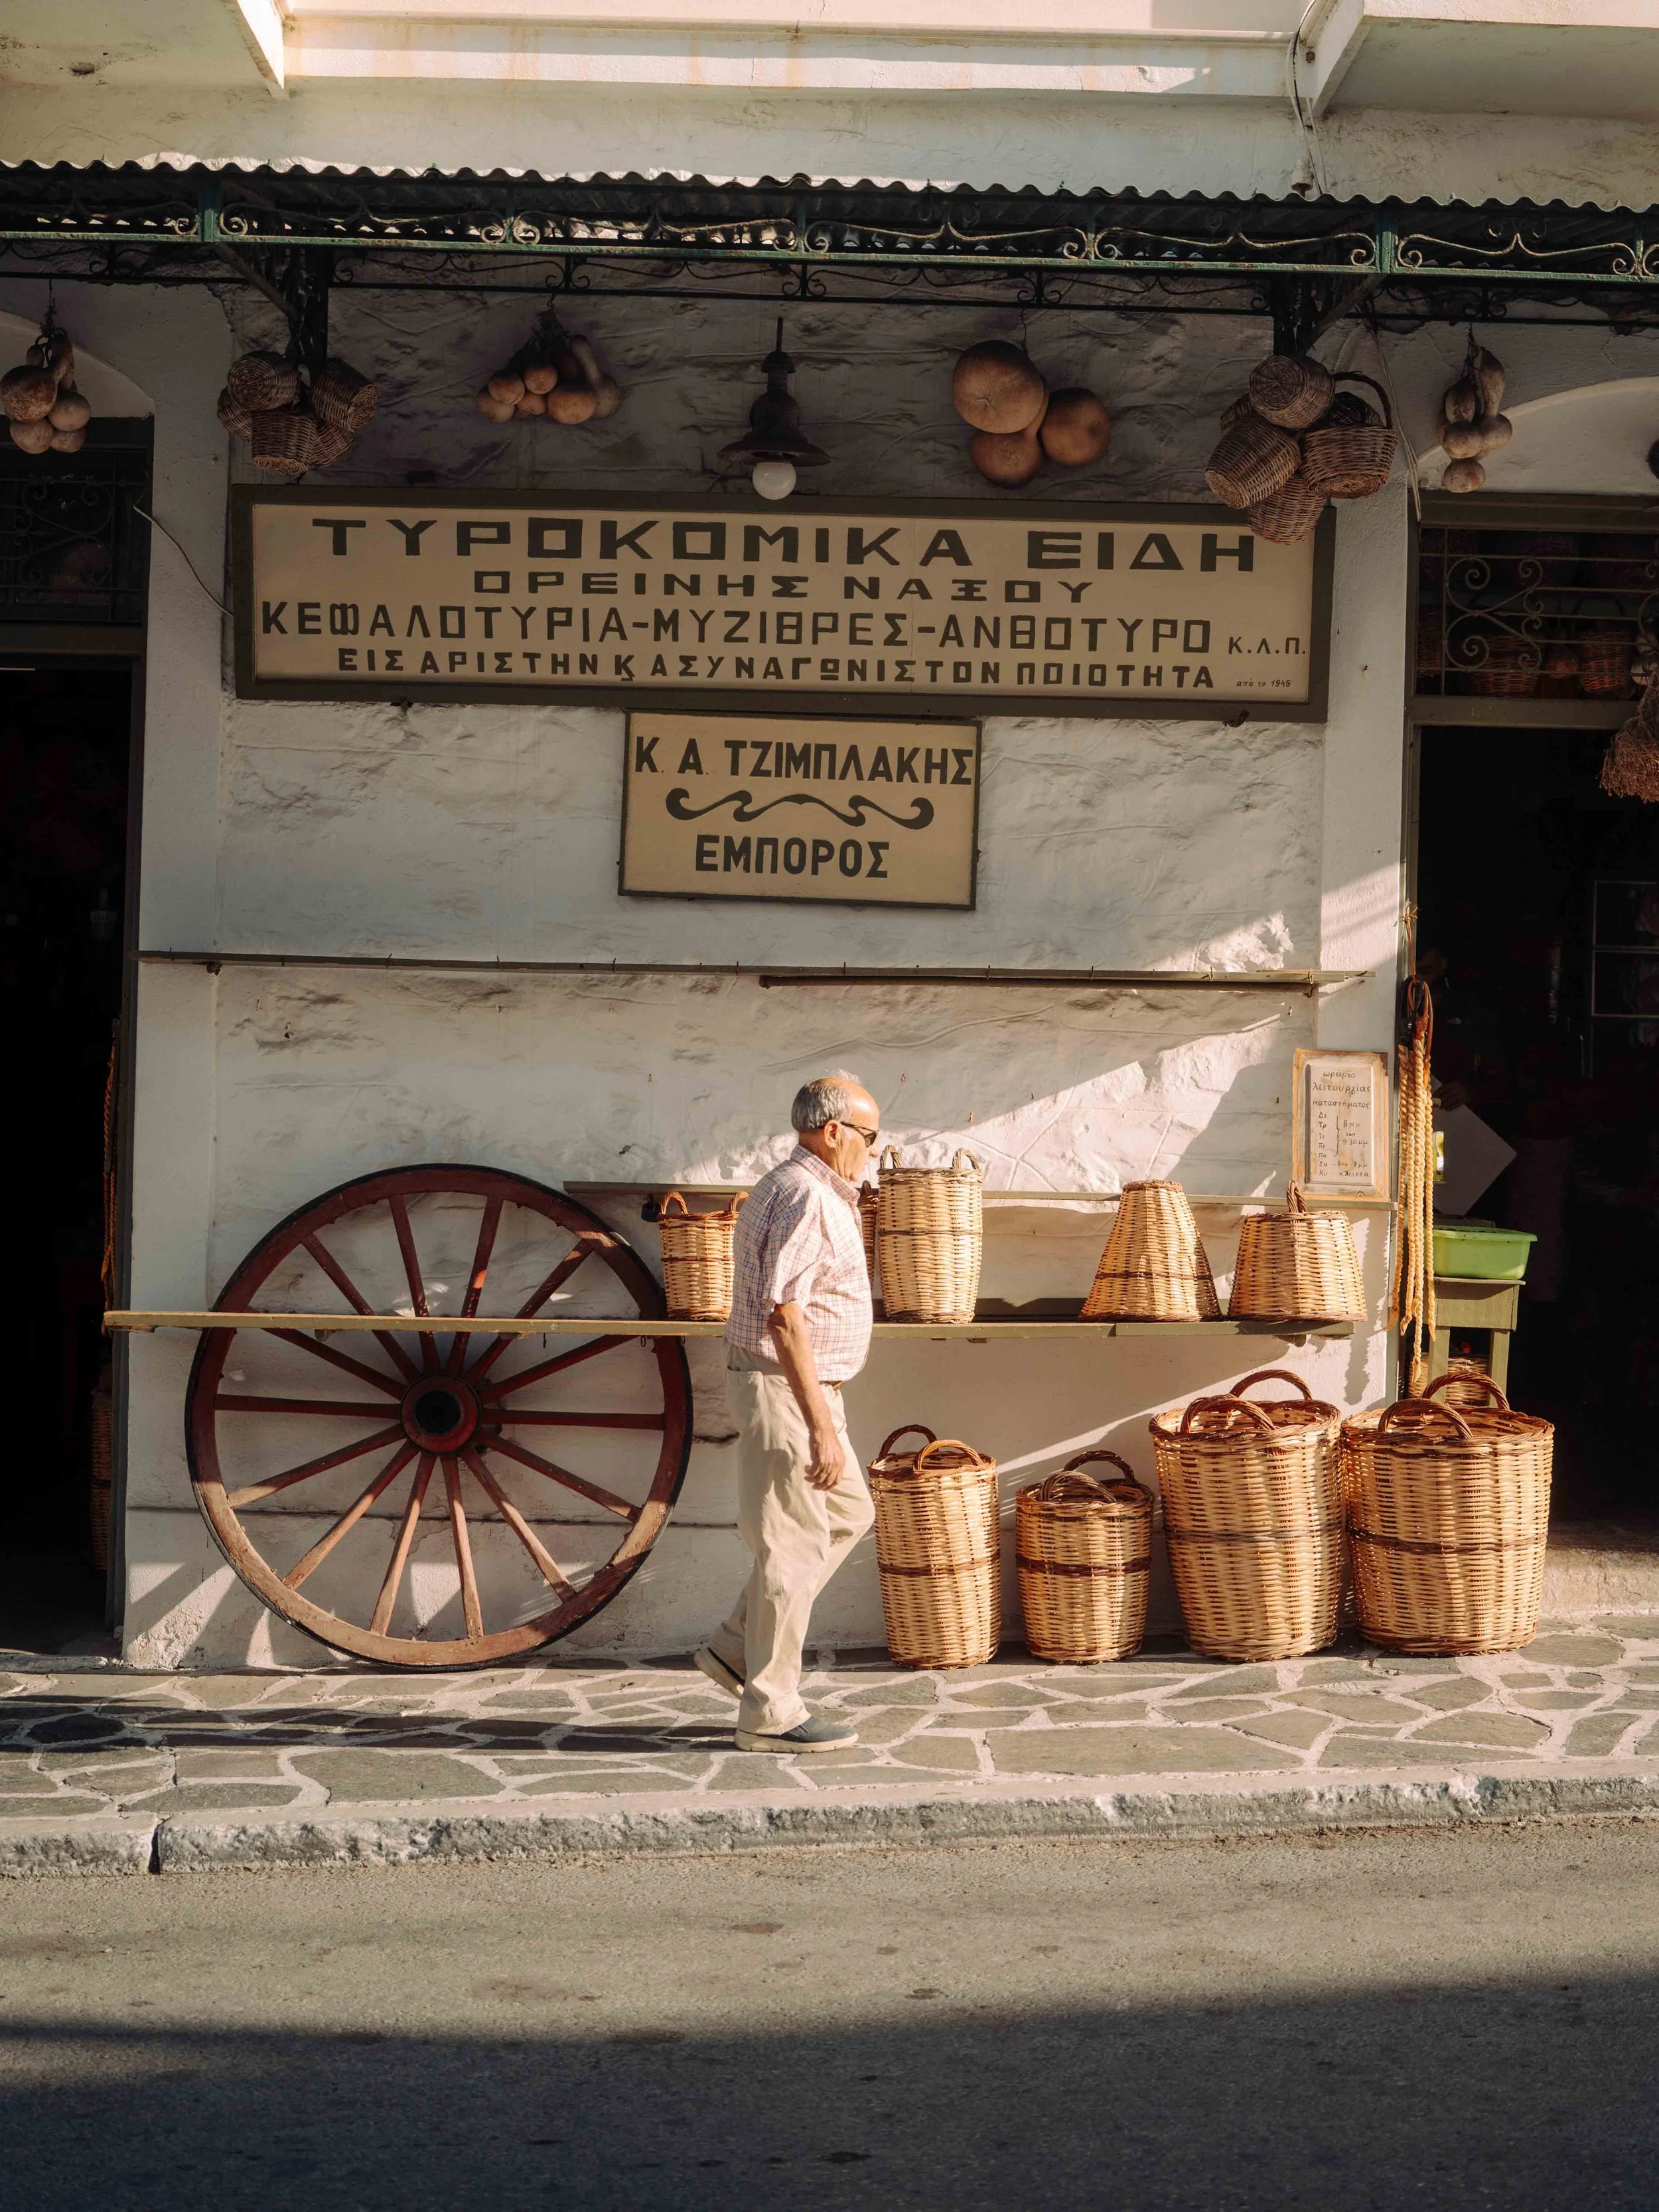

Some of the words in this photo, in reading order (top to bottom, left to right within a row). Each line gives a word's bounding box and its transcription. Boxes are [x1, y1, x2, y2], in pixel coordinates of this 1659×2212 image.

[313, 518, 974, 567] ΤΥΡΟΚΟΜΙΚΑ
[1027, 531, 1254, 573] ΕΙΔΗ
[474, 571, 809, 599] ΟΡΕΙΝΗΣ
[843, 576, 1094, 603] ΝΑΞΟΥ
[338, 648, 403, 672] ΕΙΣ
[420, 650, 599, 676] ΑΡΙΣΤΗΝ
[1016, 663, 1214, 688] ΠΟΙΟΤΗΤΑ
[1271, 679, 1291, 688] 1945
[724, 740, 974, 786] ΤΖΙΜΠΛΑΚΗΣ
[695, 834, 889, 878] ΕΜΠΟΡΟΣ
